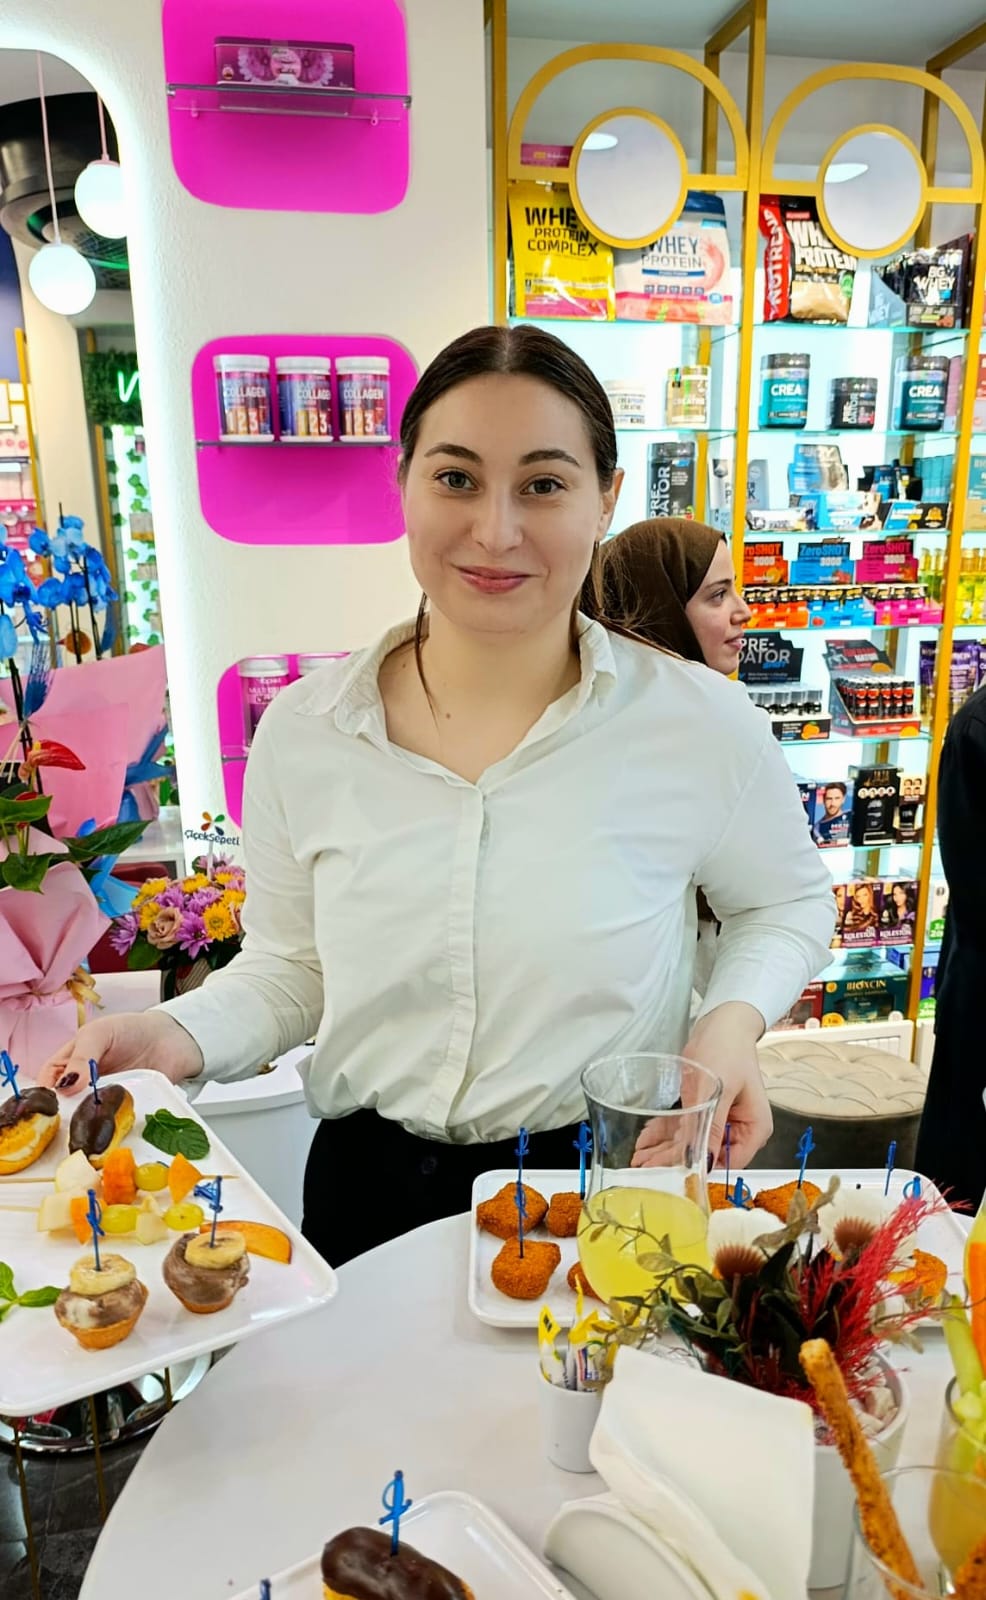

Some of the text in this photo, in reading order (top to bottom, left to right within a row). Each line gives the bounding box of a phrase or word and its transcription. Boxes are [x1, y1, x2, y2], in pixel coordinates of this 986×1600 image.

[525, 207, 578, 229] WHE
[534, 228, 589, 242] PROTEIN
[527, 239, 599, 256] COMPLEX
[641, 254, 702, 268] PROTEIN
[795, 247, 858, 272] PROTEIN
[913, 276, 956, 290] WHEY
[223, 386, 267, 398] COLLAGEN
[343, 388, 384, 400] COLLAGEN
[770, 383, 802, 396] CREA
[908, 385, 940, 398] CREA
[365, 411, 373, 433] 3
[799, 544, 848, 556] ZeroSHOT
[864, 541, 912, 554] ZeroSHOT
[184, 829, 241, 846] ÇiçekSepeti
[846, 979, 887, 990] BIOXCIN
